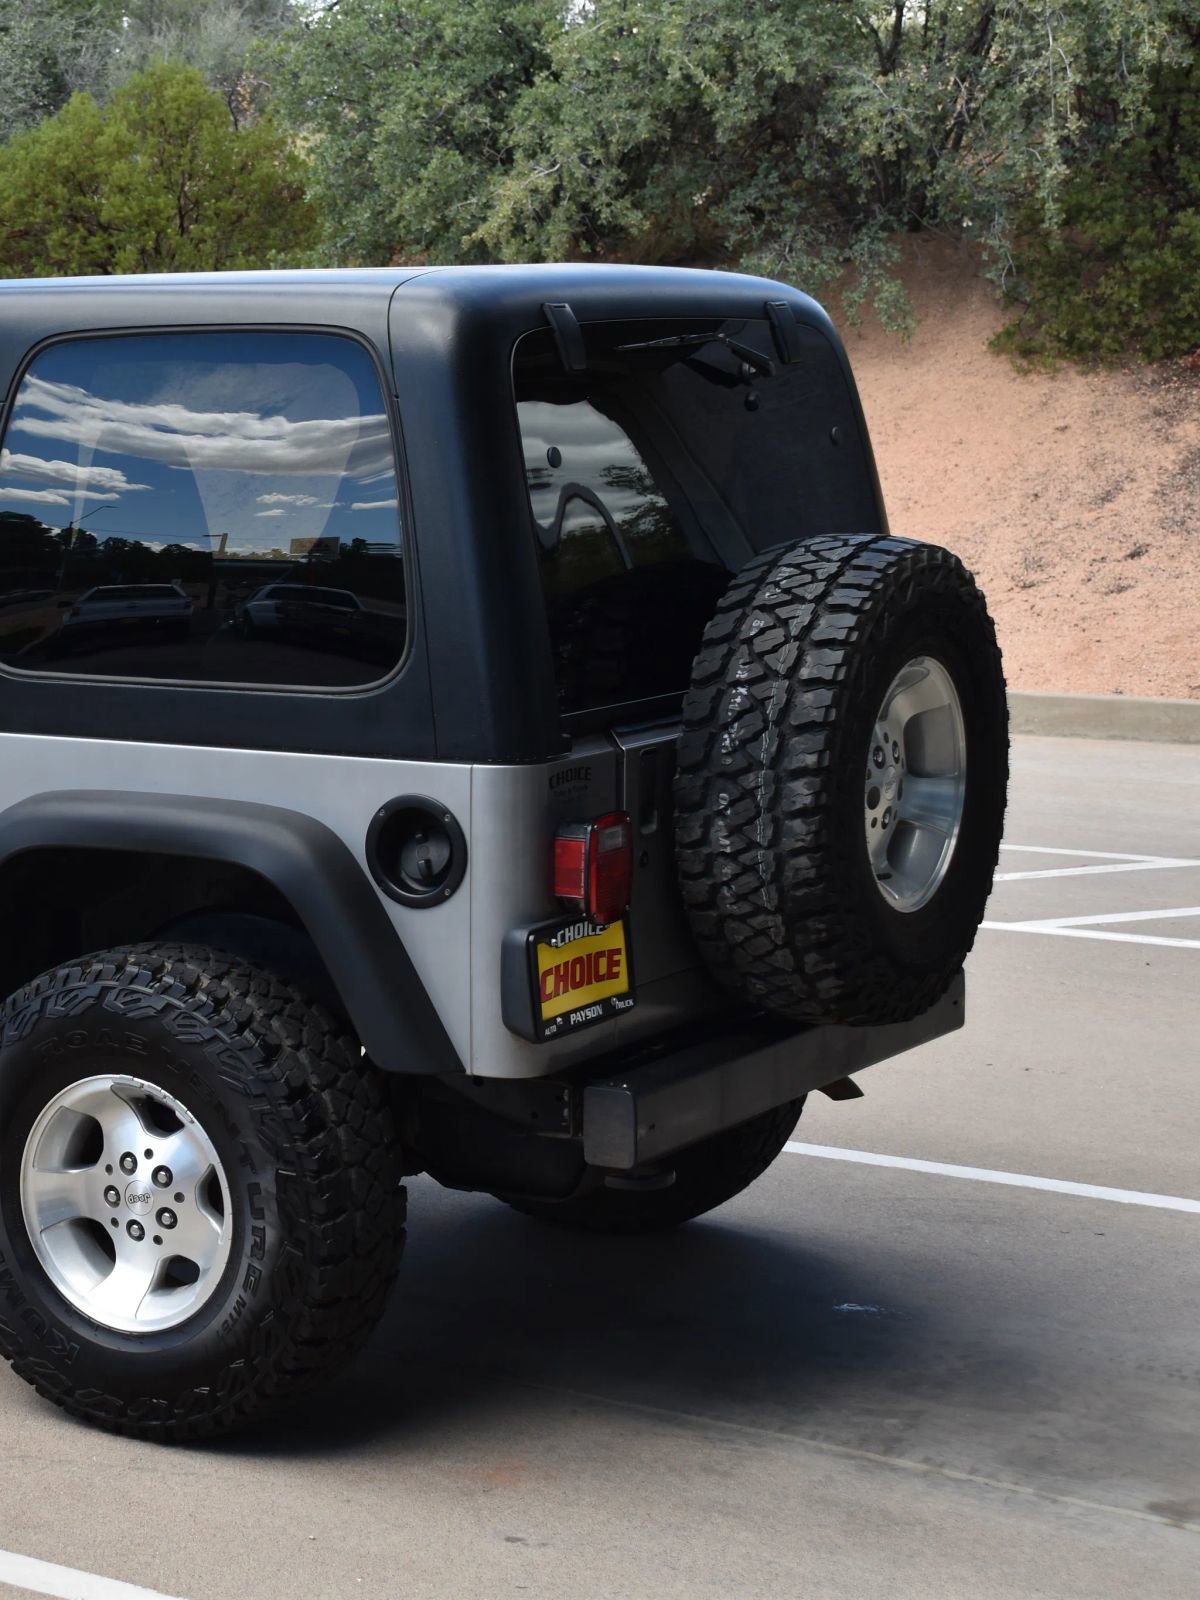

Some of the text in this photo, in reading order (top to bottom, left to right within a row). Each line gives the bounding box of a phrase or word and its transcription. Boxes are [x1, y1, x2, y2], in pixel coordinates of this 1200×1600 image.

[548, 767, 592, 790] CHOICE
[541, 948, 622, 1003] CHOICE
[544, 1025, 557, 1036] AUTO
[570, 1004, 603, 1025] PAYSON
